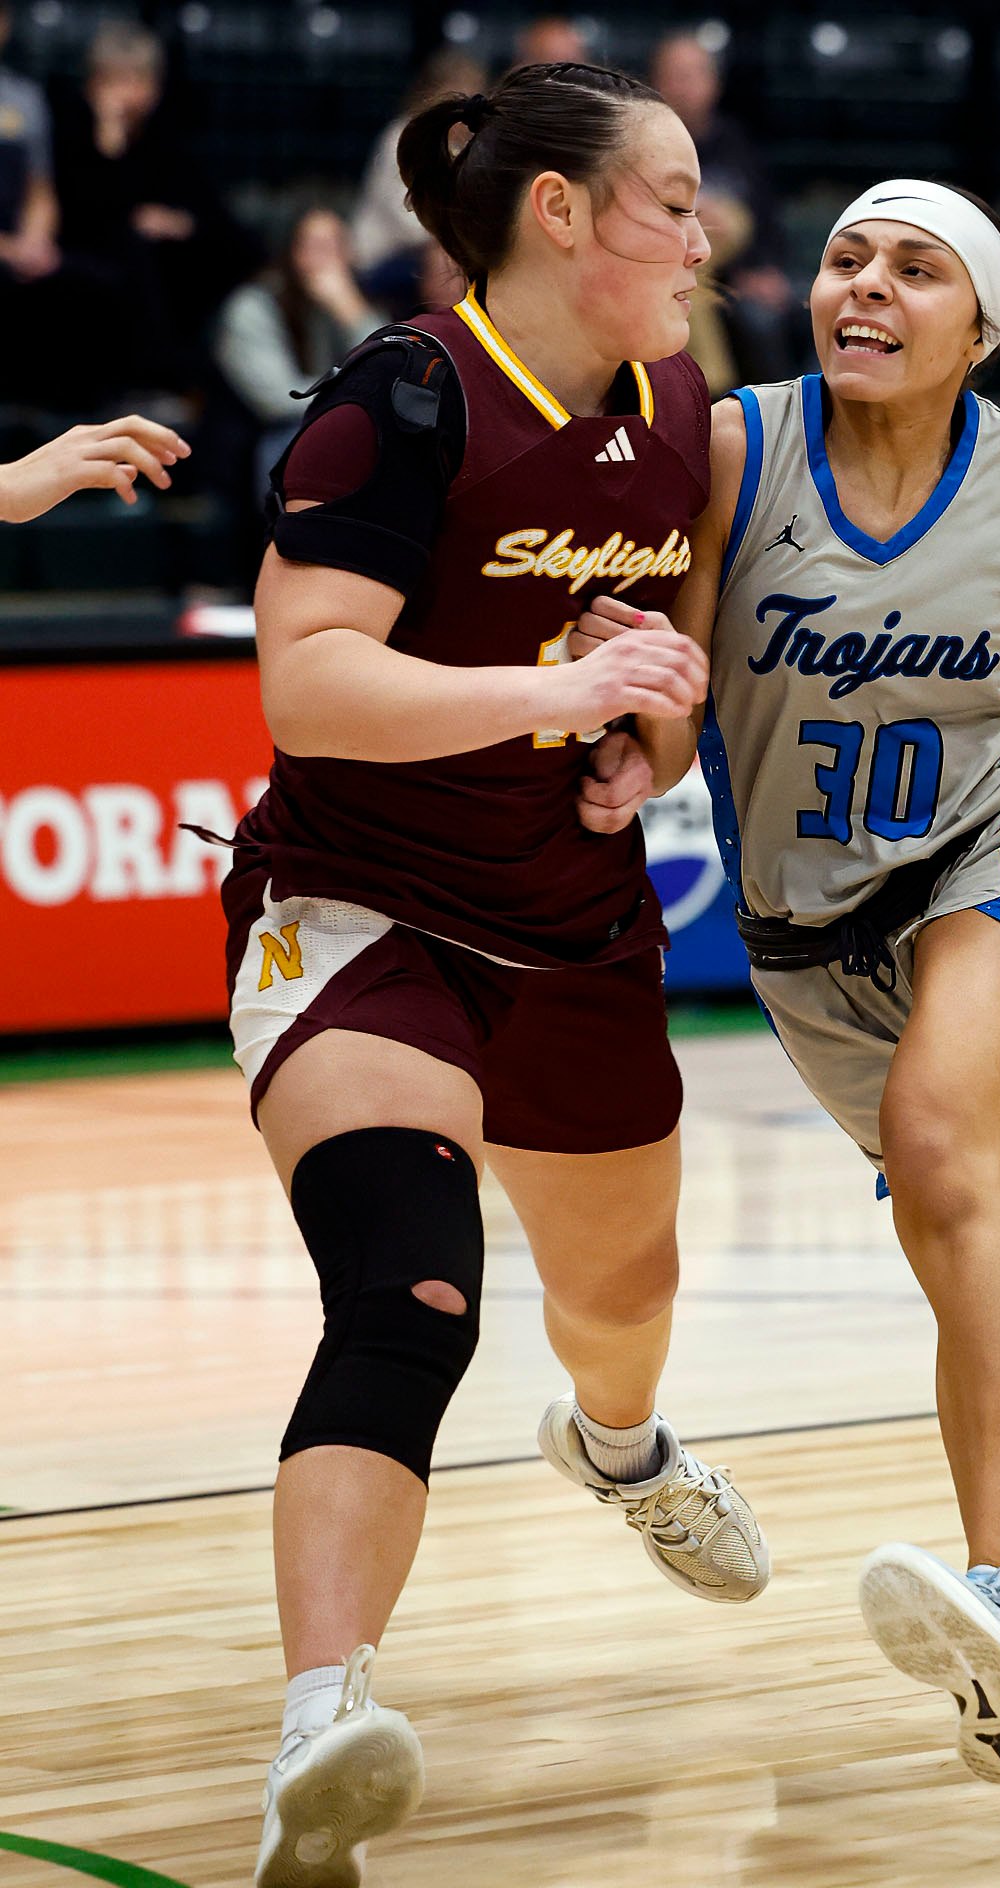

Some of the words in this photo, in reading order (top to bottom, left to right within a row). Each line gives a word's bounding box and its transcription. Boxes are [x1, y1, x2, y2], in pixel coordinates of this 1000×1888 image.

[481, 528, 691, 594] Skylight
[747, 593, 1000, 699] Trojans
[796, 717, 944, 846] 30
[257, 920, 304, 992] N
